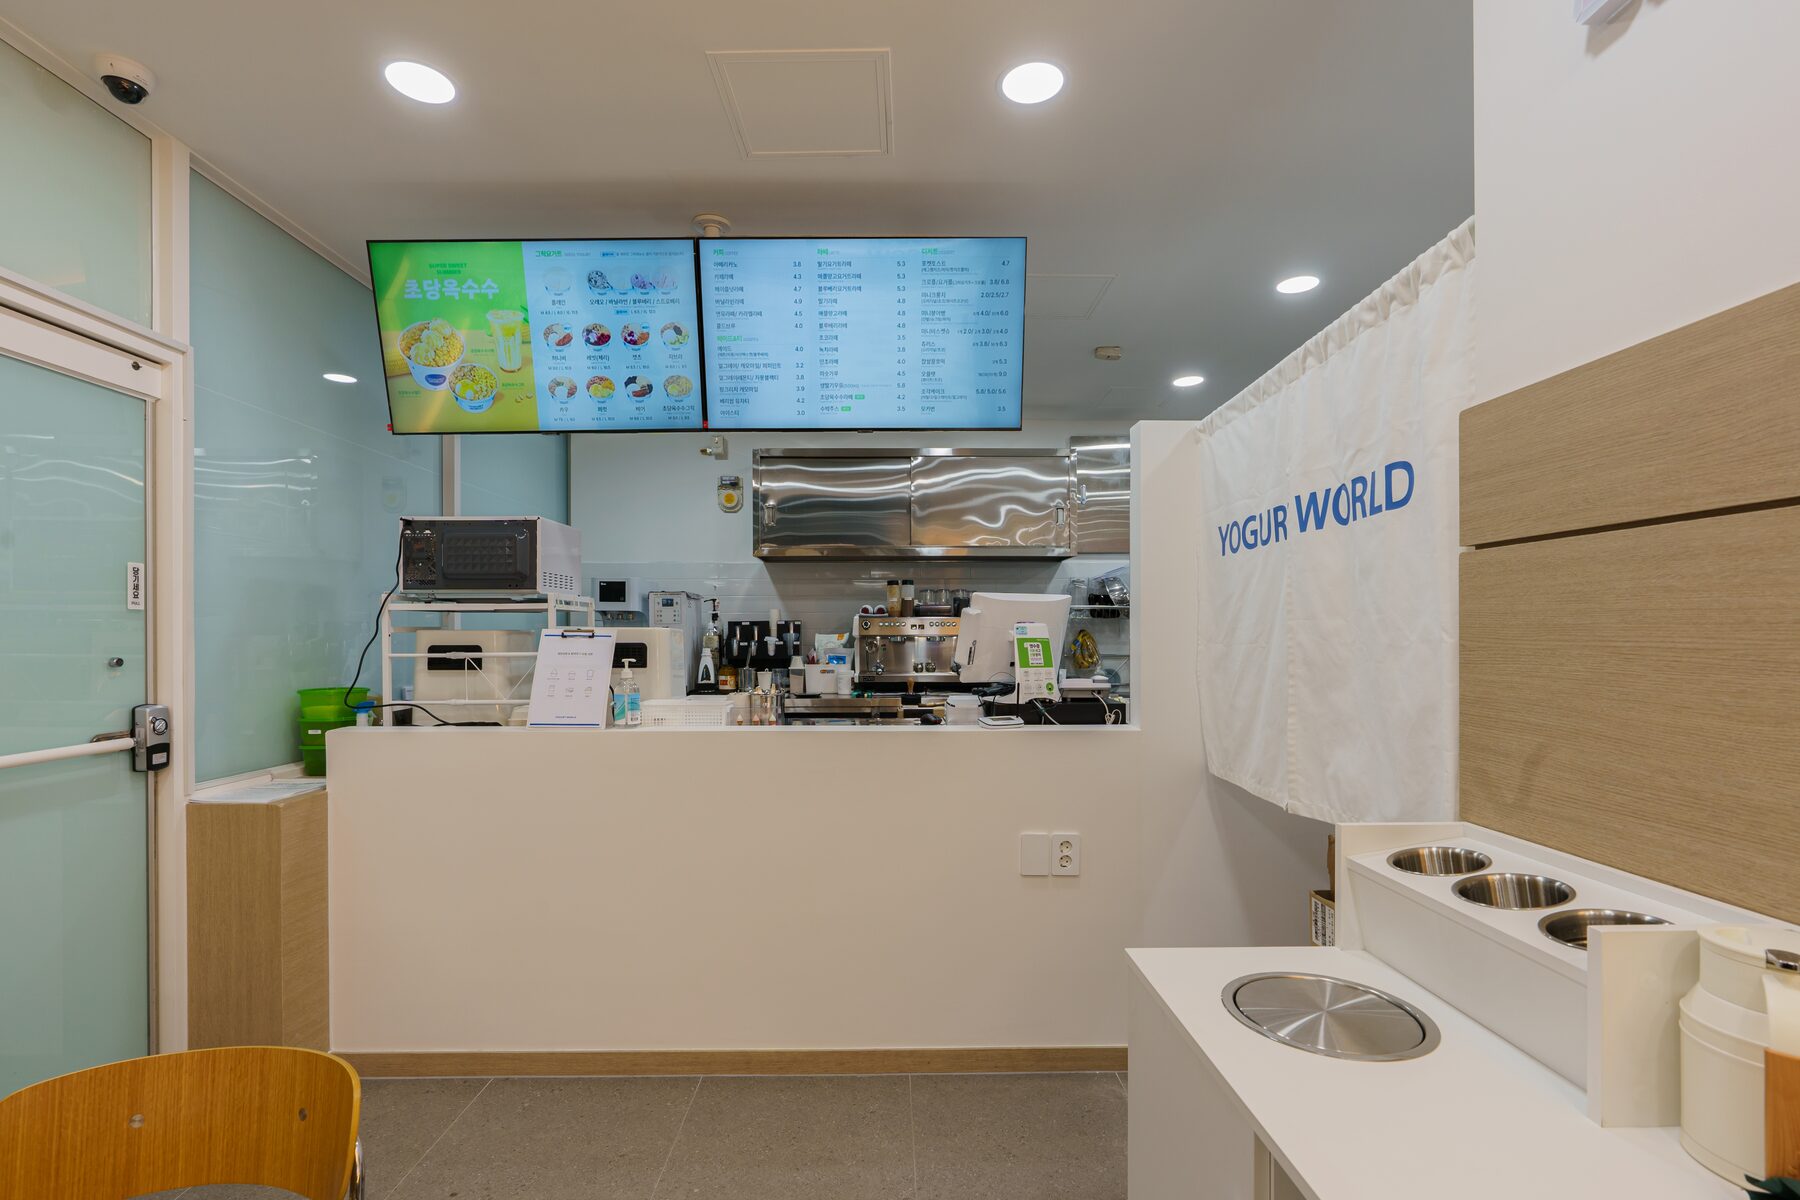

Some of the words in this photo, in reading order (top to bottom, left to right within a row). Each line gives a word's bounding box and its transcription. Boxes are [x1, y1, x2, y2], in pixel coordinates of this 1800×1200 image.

[404, 278, 499, 300] 초당옥수수
[1218, 502, 1288, 556] YOGUR
[1294, 460, 1415, 533] WORLD
